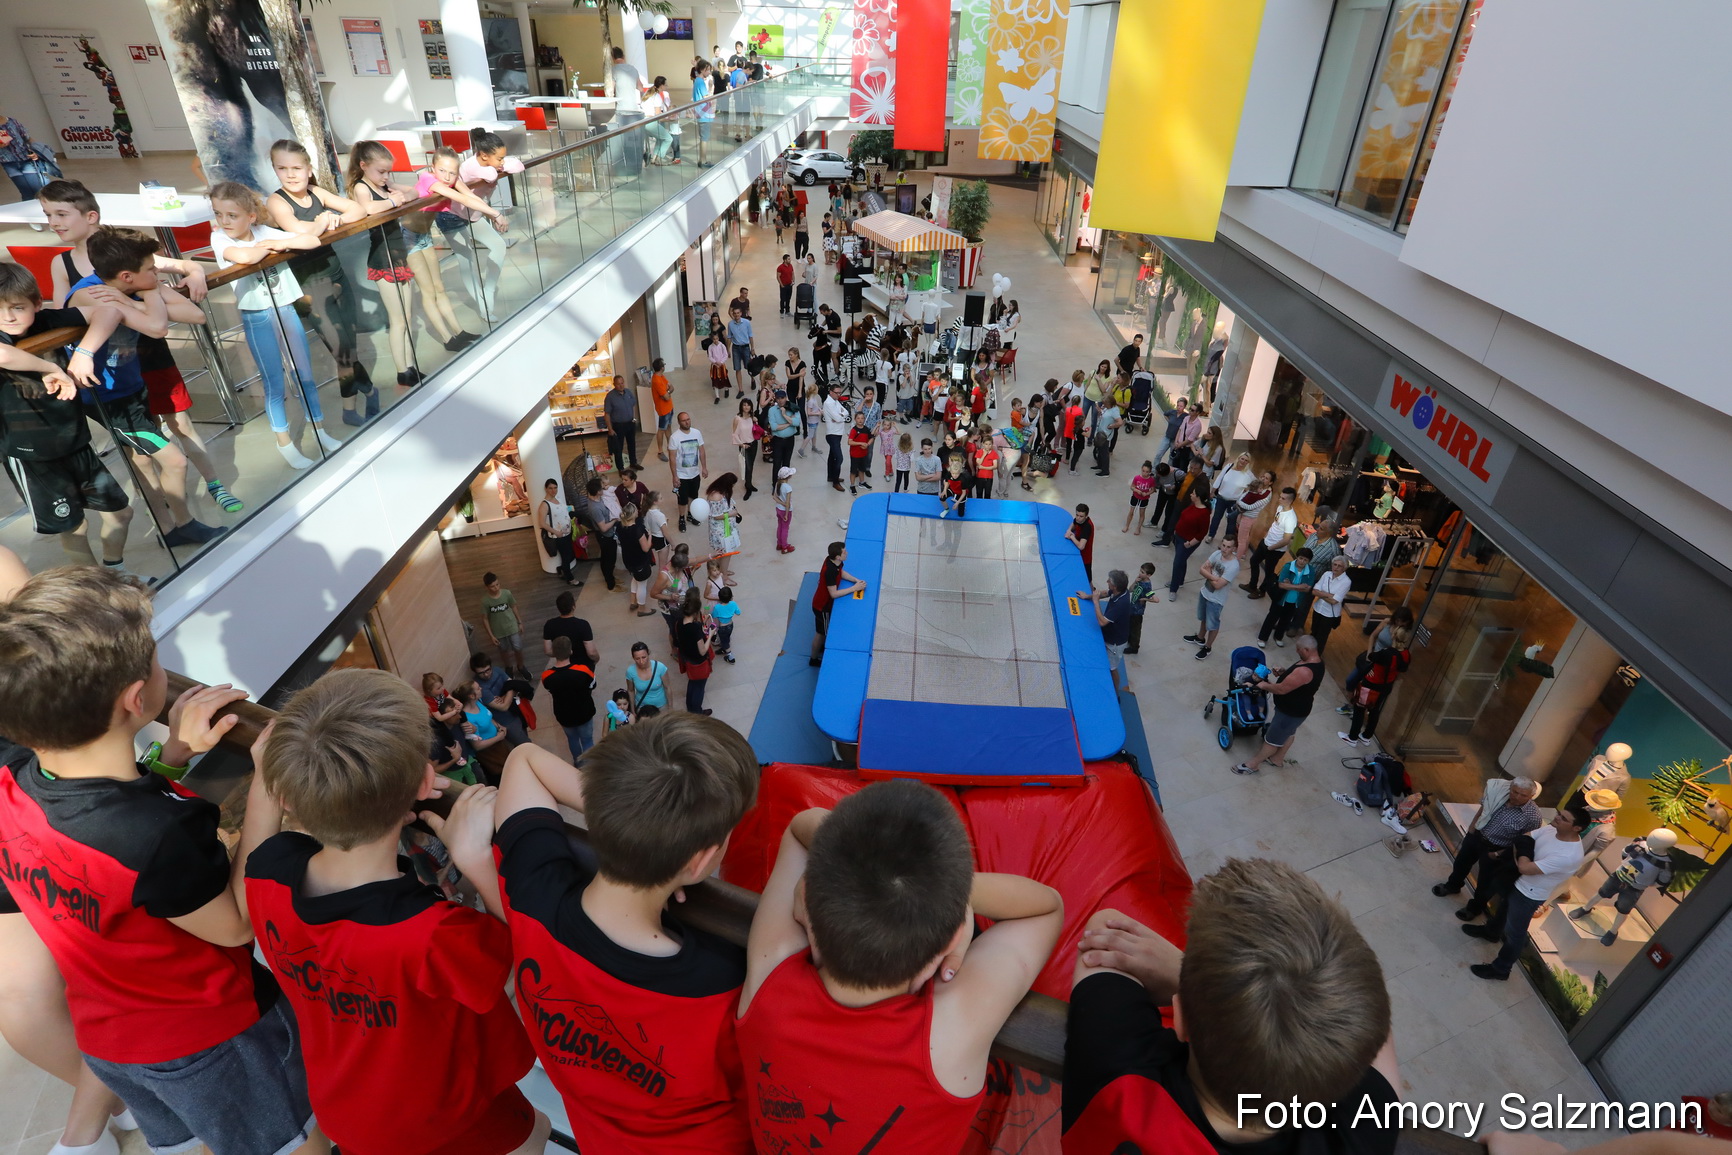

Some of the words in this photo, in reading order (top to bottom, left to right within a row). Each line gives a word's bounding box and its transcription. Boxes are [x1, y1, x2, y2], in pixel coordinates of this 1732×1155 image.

[246, 61, 280, 70] BIGGER
[61, 128, 114, 142] GNOMES
[1390, 373, 1493, 483] WÖHRL
